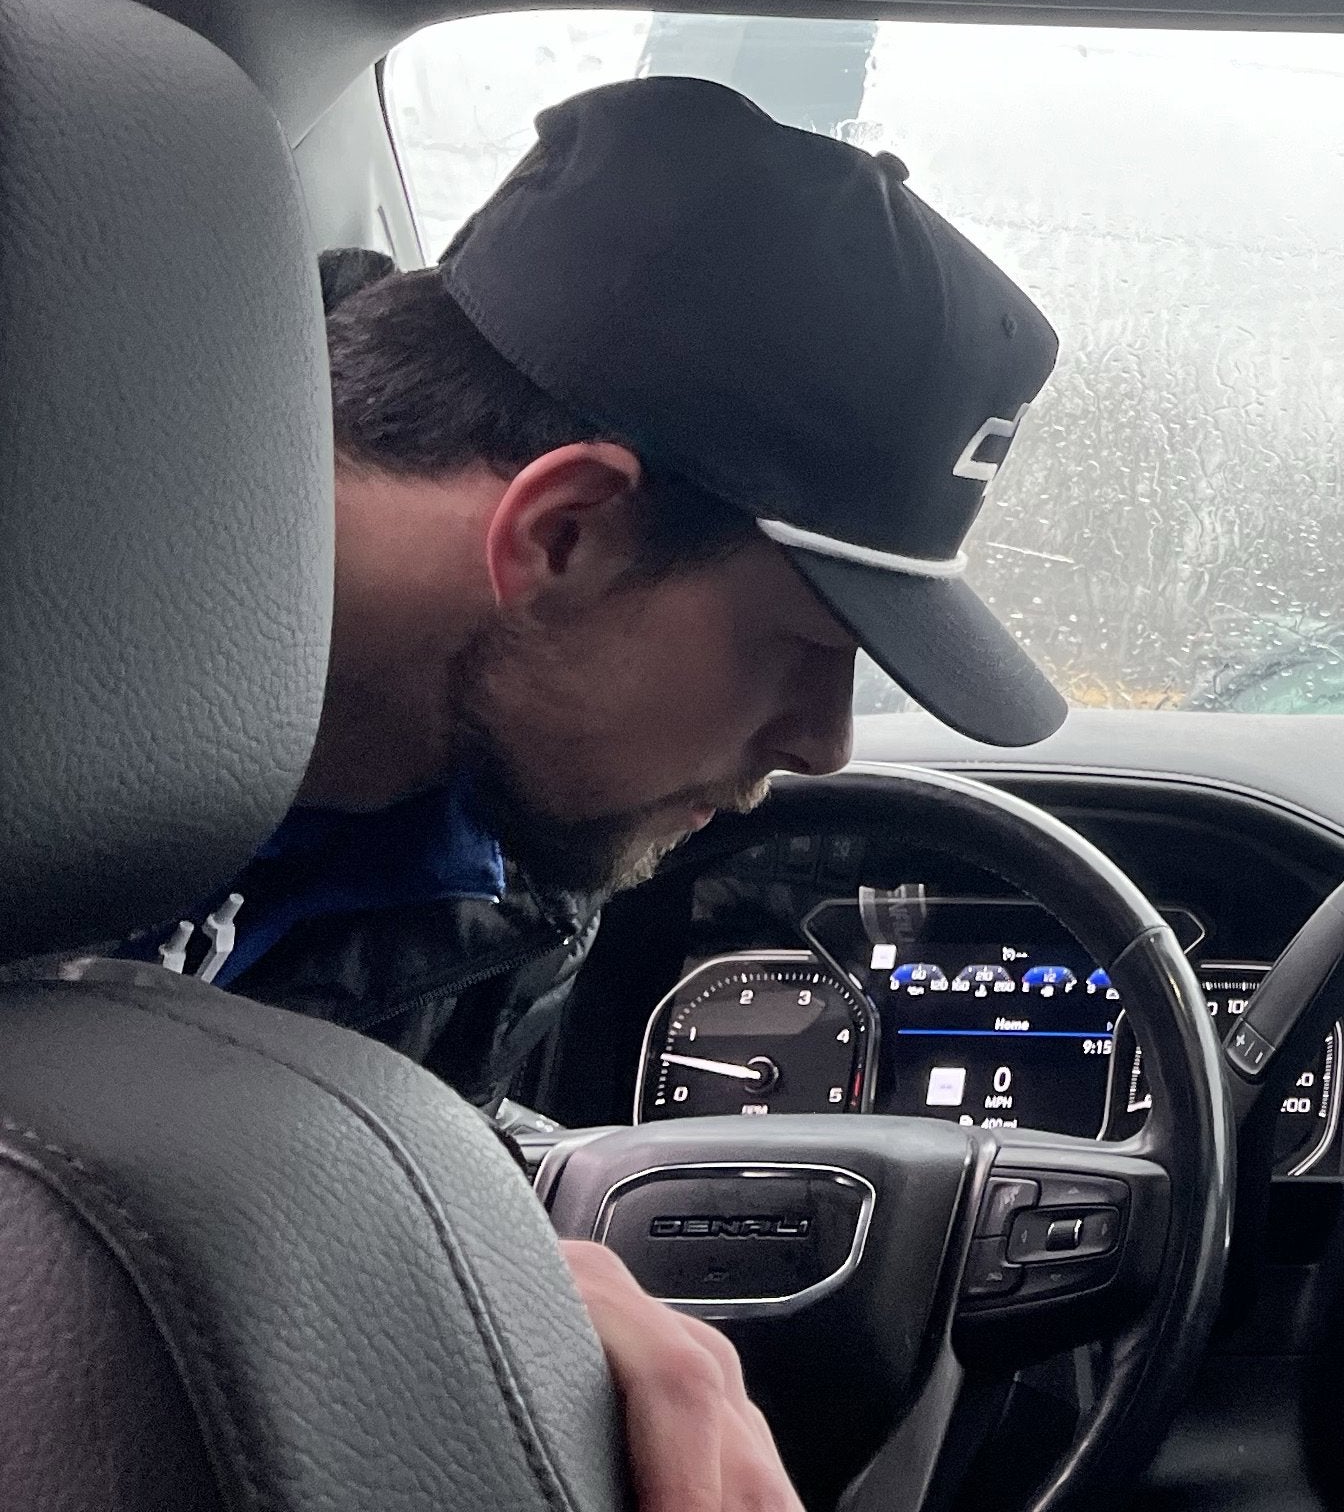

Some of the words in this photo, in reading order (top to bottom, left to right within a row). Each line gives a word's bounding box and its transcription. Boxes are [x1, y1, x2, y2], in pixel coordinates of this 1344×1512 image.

[739, 989, 754, 1005] 2
[798, 989, 812, 1006] 3
[995, 1017, 1030, 1031] Home
[689, 1026, 697, 1042] 1
[836, 1028, 850, 1044] 4
[1082, 1040, 1112, 1055] 9:15
[993, 1066, 1012, 1092] 0
[673, 1086, 688, 1102] 0
[828, 1087, 843, 1104] 5
[984, 1095, 1013, 1109] MPH
[651, 1217, 811, 1238] DENALI
